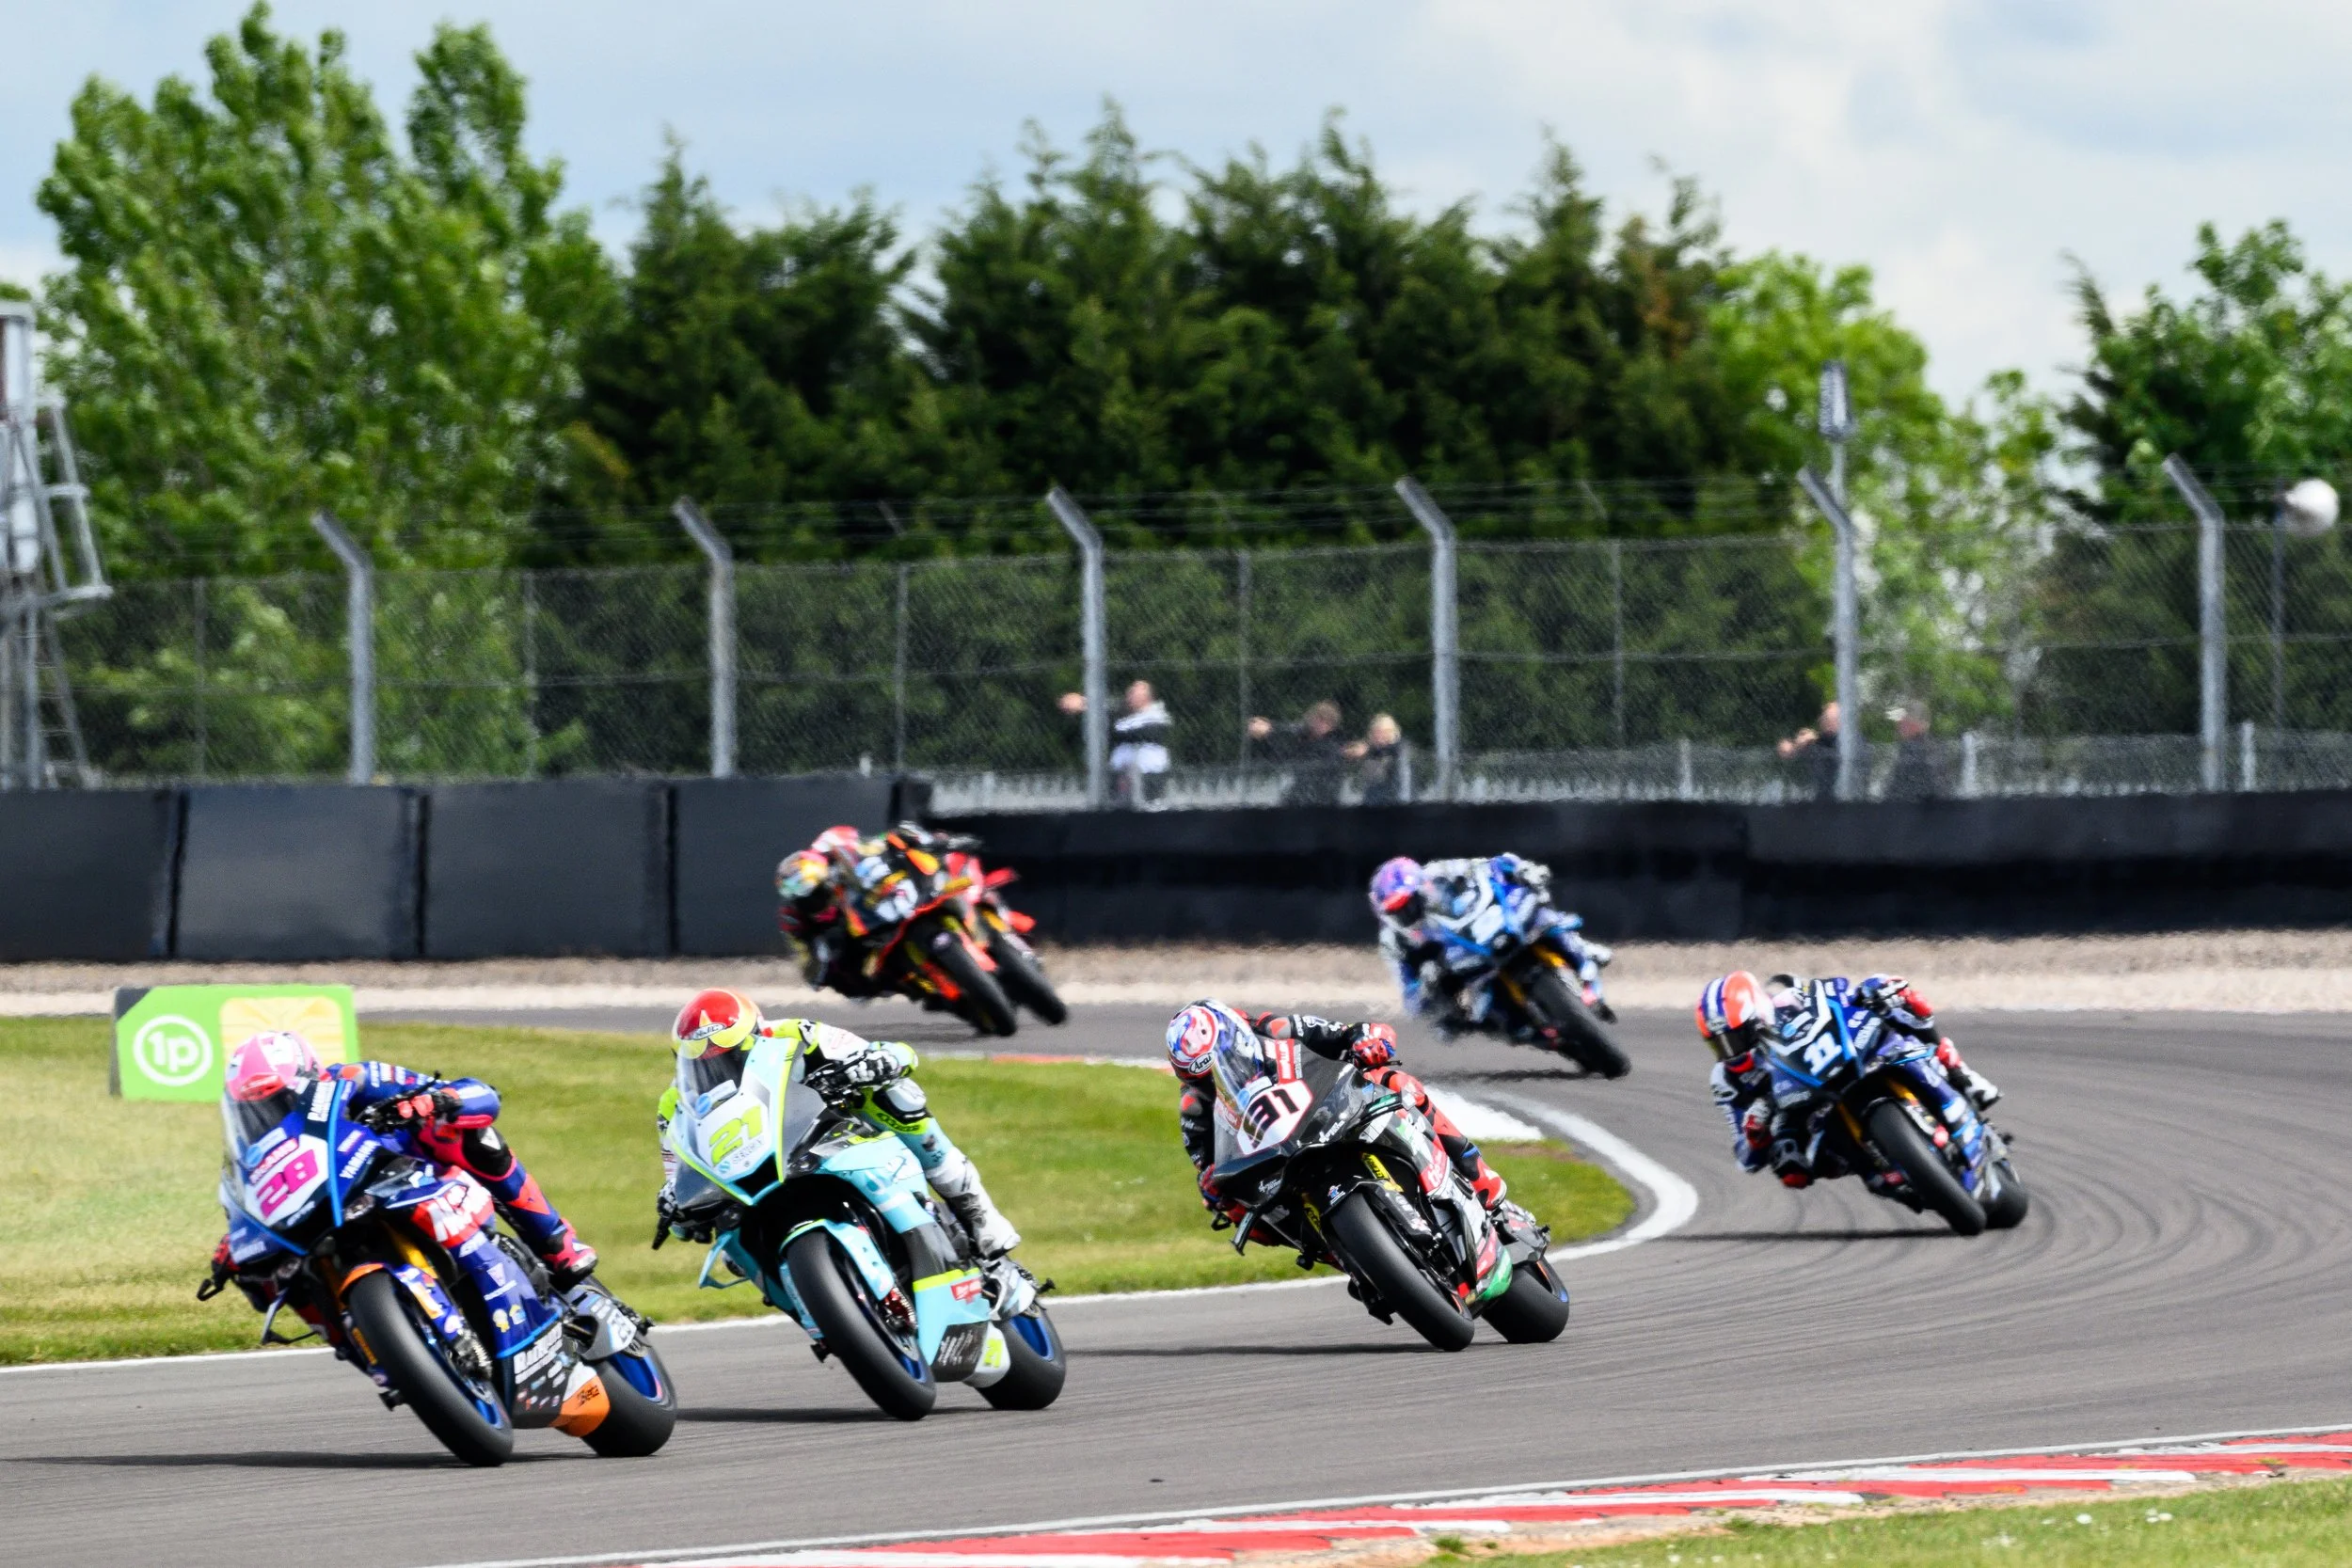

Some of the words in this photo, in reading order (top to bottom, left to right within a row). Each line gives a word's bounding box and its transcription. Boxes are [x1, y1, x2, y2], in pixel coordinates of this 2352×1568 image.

[147, 1031, 199, 1073] 1p
[1194, 1053, 1213, 1070] Arai
[708, 1105, 763, 1166] 21
[1243, 1088, 1299, 1149] 31
[256, 1148, 319, 1220] 28
